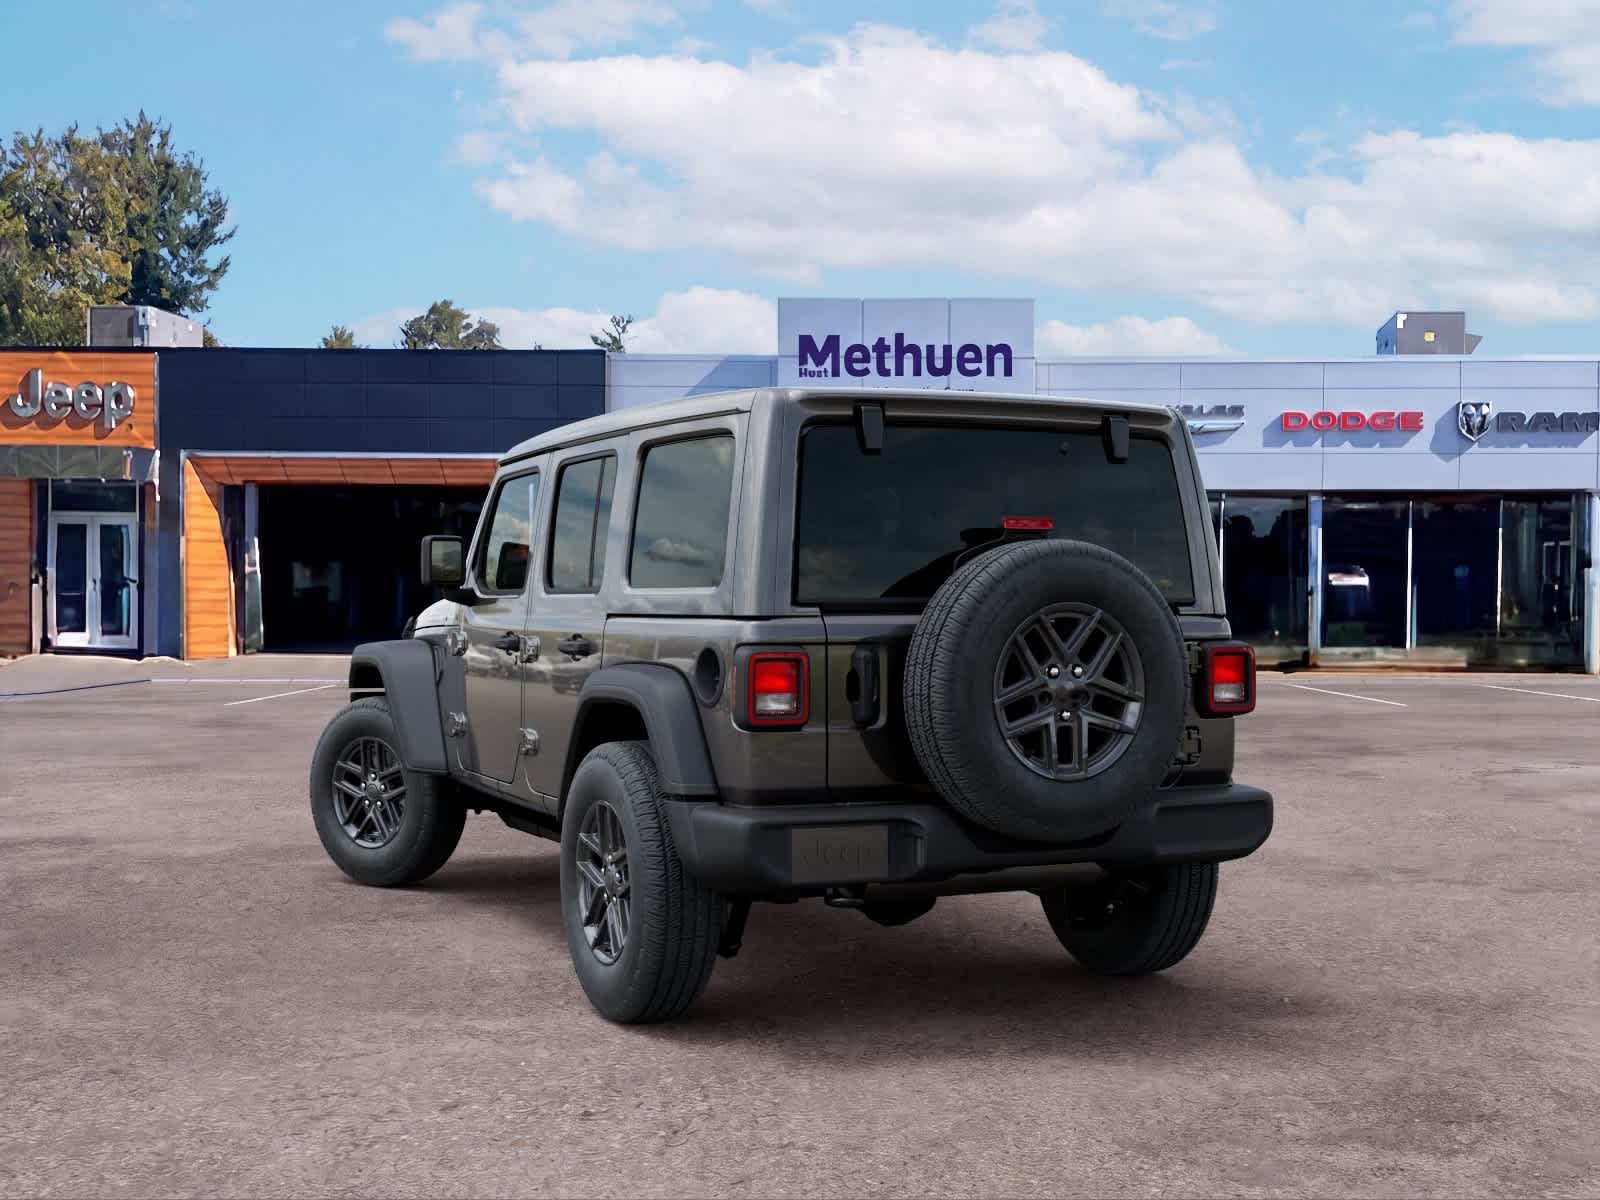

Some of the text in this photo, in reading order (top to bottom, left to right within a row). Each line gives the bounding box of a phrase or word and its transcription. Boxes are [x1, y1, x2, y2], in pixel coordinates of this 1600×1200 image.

[798, 332, 1013, 378] Methuen
[8, 367, 135, 430] Jeep
[1282, 411, 1424, 433] DODGE
[1496, 411, 1600, 433] RAM
